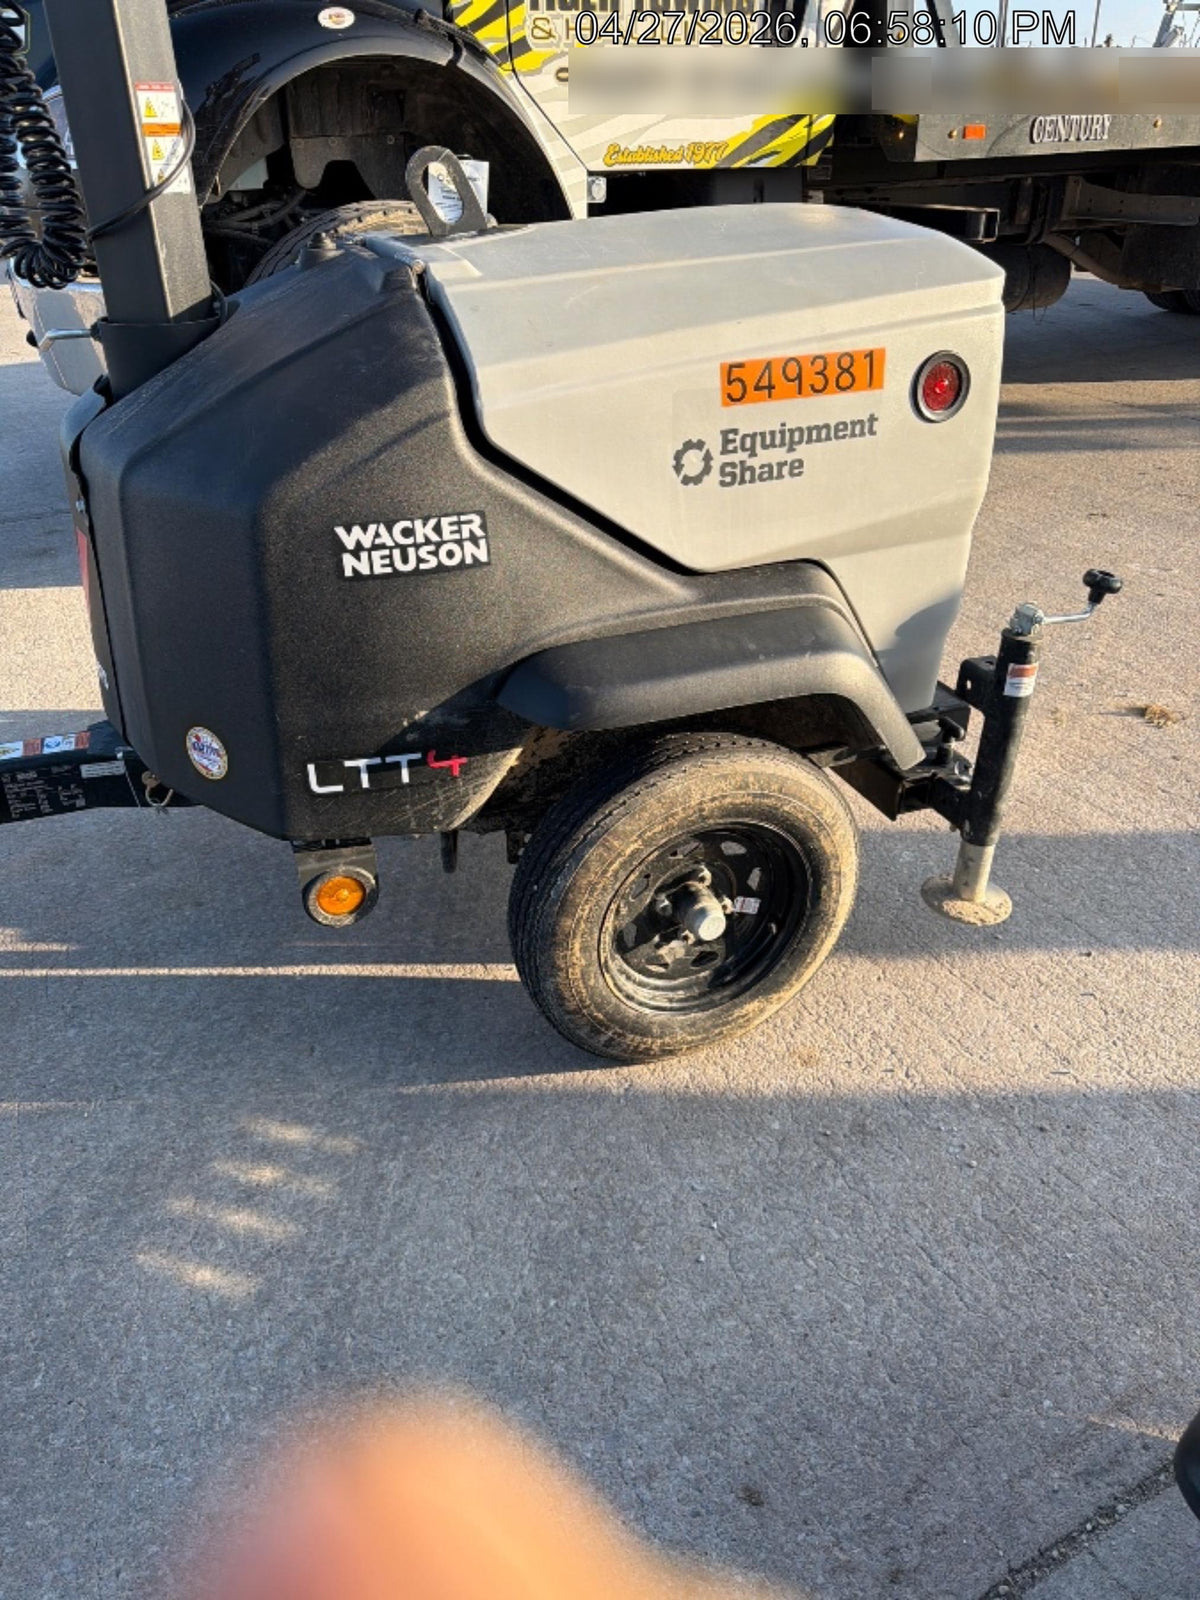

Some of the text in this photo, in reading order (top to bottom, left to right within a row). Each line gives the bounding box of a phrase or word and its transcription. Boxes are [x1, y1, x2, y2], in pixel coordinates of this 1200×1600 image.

[531, 17, 555, 39] &
[1030, 113, 1112, 144] CENTURY
[603, 140, 729, 167] Established 1977
[725, 350, 876, 403] 549381
[719, 413, 879, 458] Equipment
[718, 457, 805, 488] Share
[334, 513, 487, 550] WACKER
[342, 538, 490, 578] NEUSON
